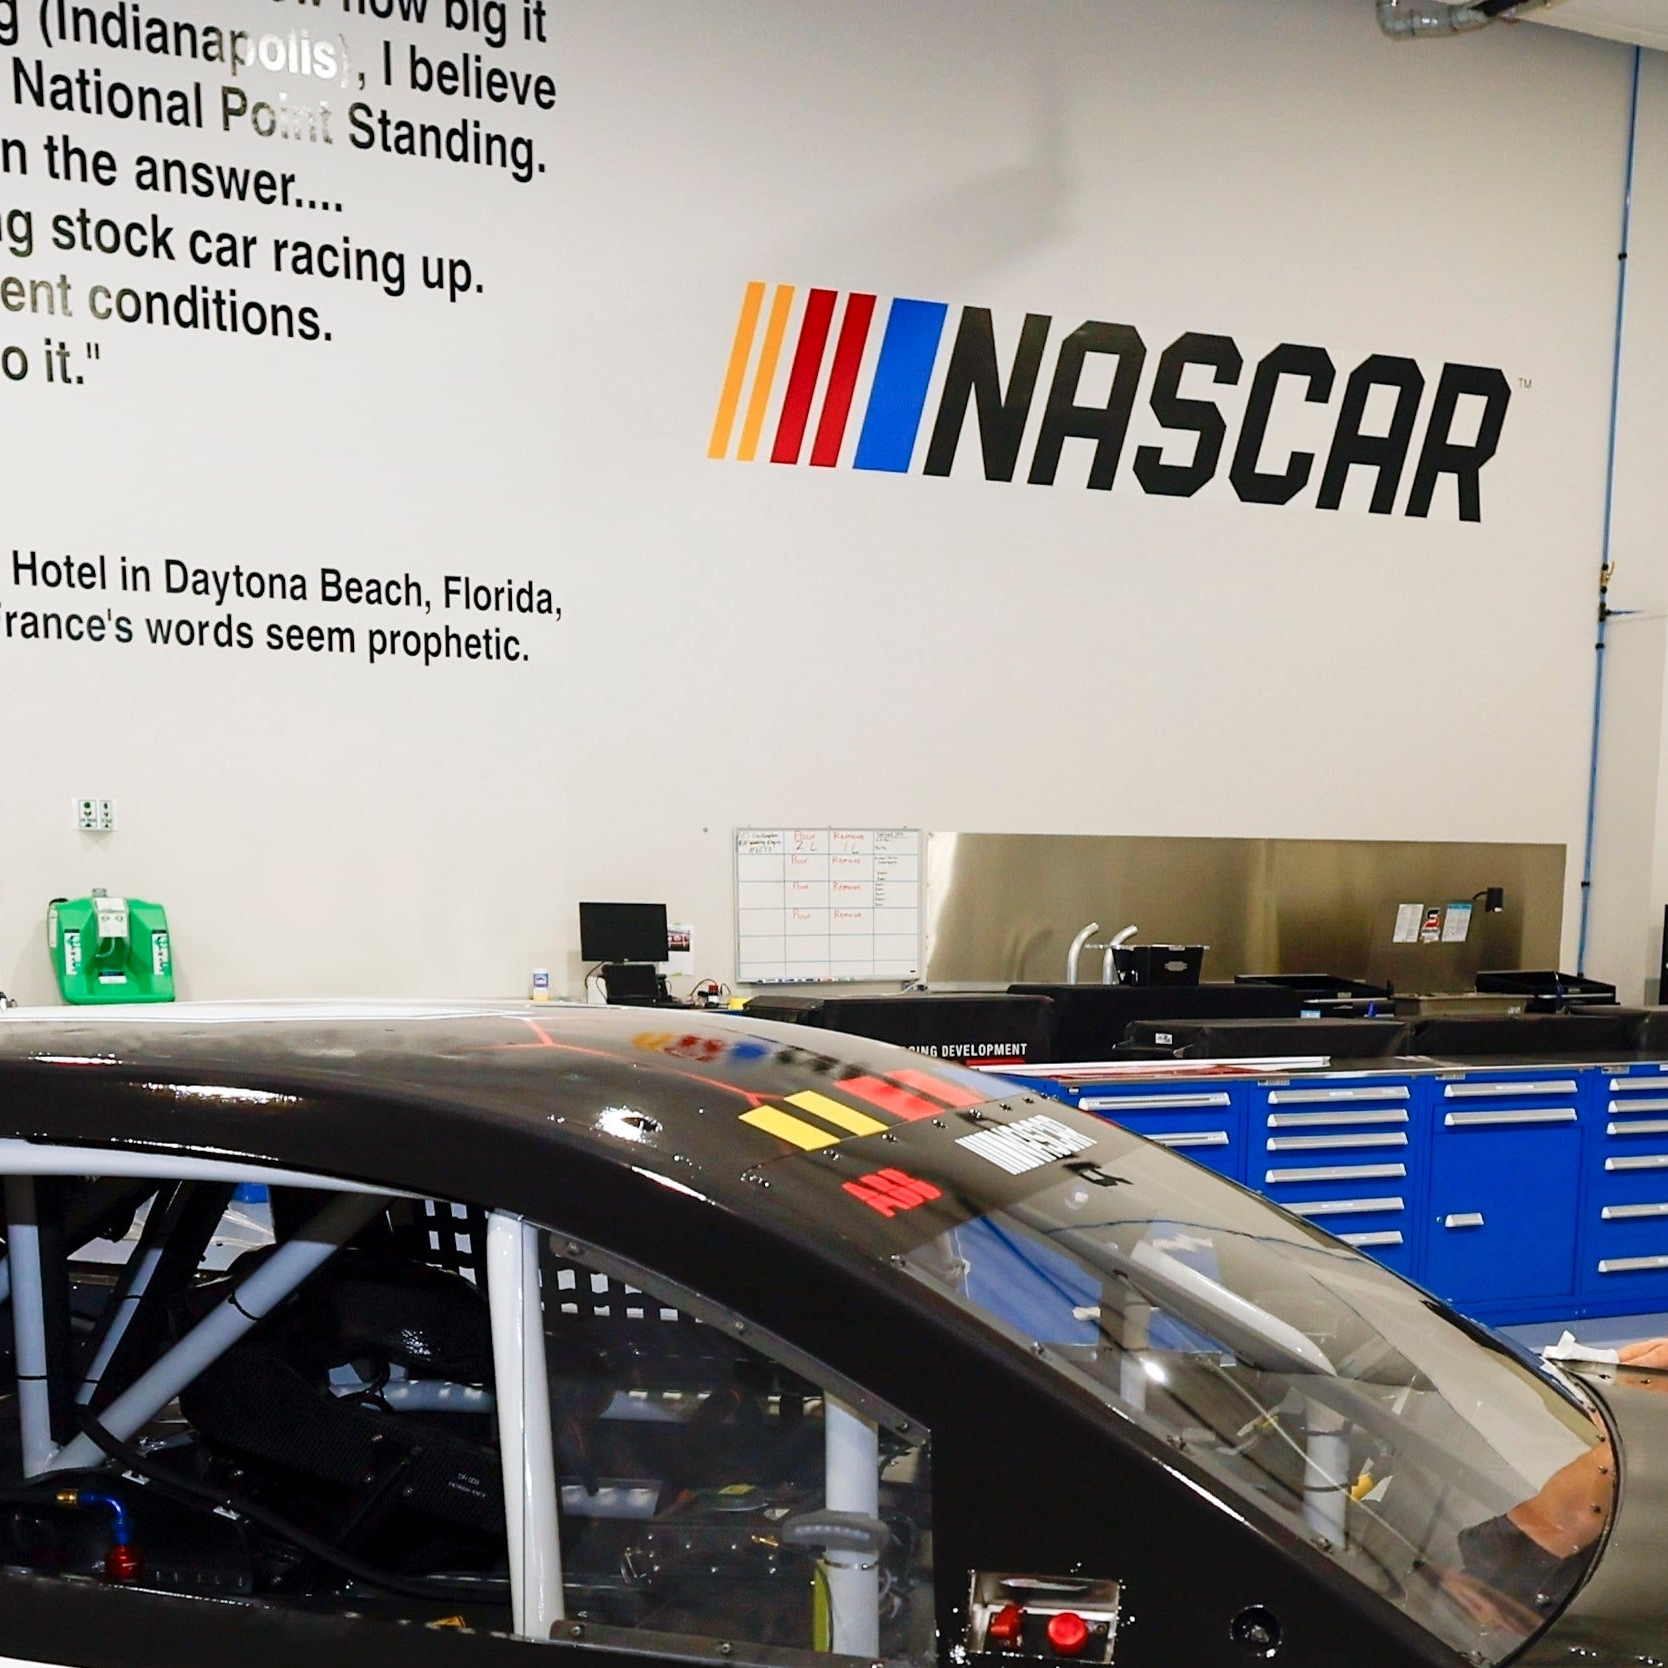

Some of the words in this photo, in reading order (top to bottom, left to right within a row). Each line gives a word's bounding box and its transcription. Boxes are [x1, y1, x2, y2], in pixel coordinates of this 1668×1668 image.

[444, 0, 508, 49] big
[522, 0, 548, 44] it
[382, 39, 393, 87] I
[408, 43, 557, 111] believe
[11, 55, 204, 129] National
[347, 101, 546, 184] Standing.
[42, 133, 118, 187] the
[134, 154, 343, 213] answer....
[51, 207, 177, 262] stock
[188, 228, 258, 270] car
[273, 235, 406, 298] racing
[421, 255, 484, 304] up.
[88, 283, 333, 342] conditions.
[922, 305, 1513, 523] NASCAR
[11, 549, 107, 591] Hotel
[120, 555, 151, 593] in
[163, 558, 308, 607] Daytona
[320, 567, 431, 616] Beach,
[443, 575, 562, 622] Florida,
[144, 612, 254, 650] words
[265, 622, 356, 654] seem
[367, 624, 529, 667] prophetic.
[941, 1043, 1028, 1058] DEVELOPMENT
